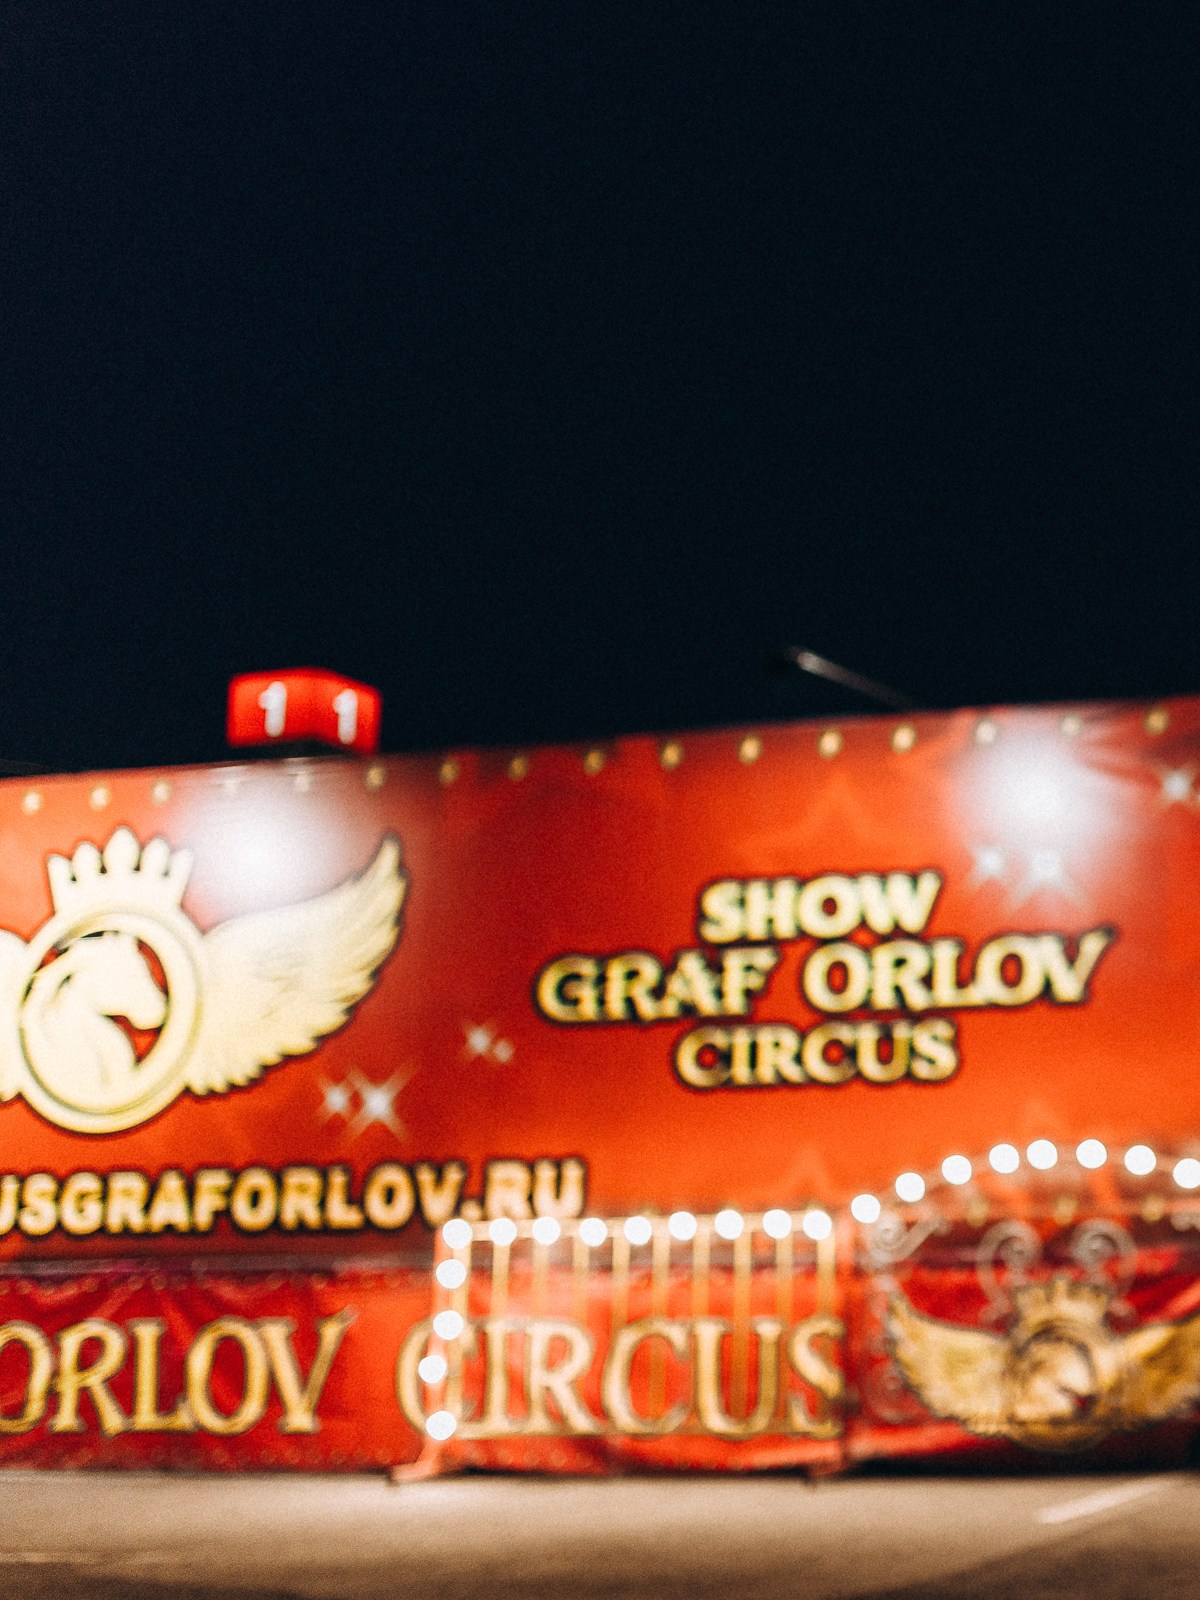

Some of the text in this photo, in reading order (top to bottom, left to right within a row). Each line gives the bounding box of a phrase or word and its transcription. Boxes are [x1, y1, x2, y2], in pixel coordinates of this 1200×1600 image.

[258, 680, 287, 738] 1
[332, 688, 359, 745] 1
[700, 870, 942, 944] SHOW
[537, 928, 1116, 1024] GRAF ORLOV
[676, 1017, 959, 1087] CIRCUS
[0, 1305, 846, 1441] ORLOV CIRCUS
